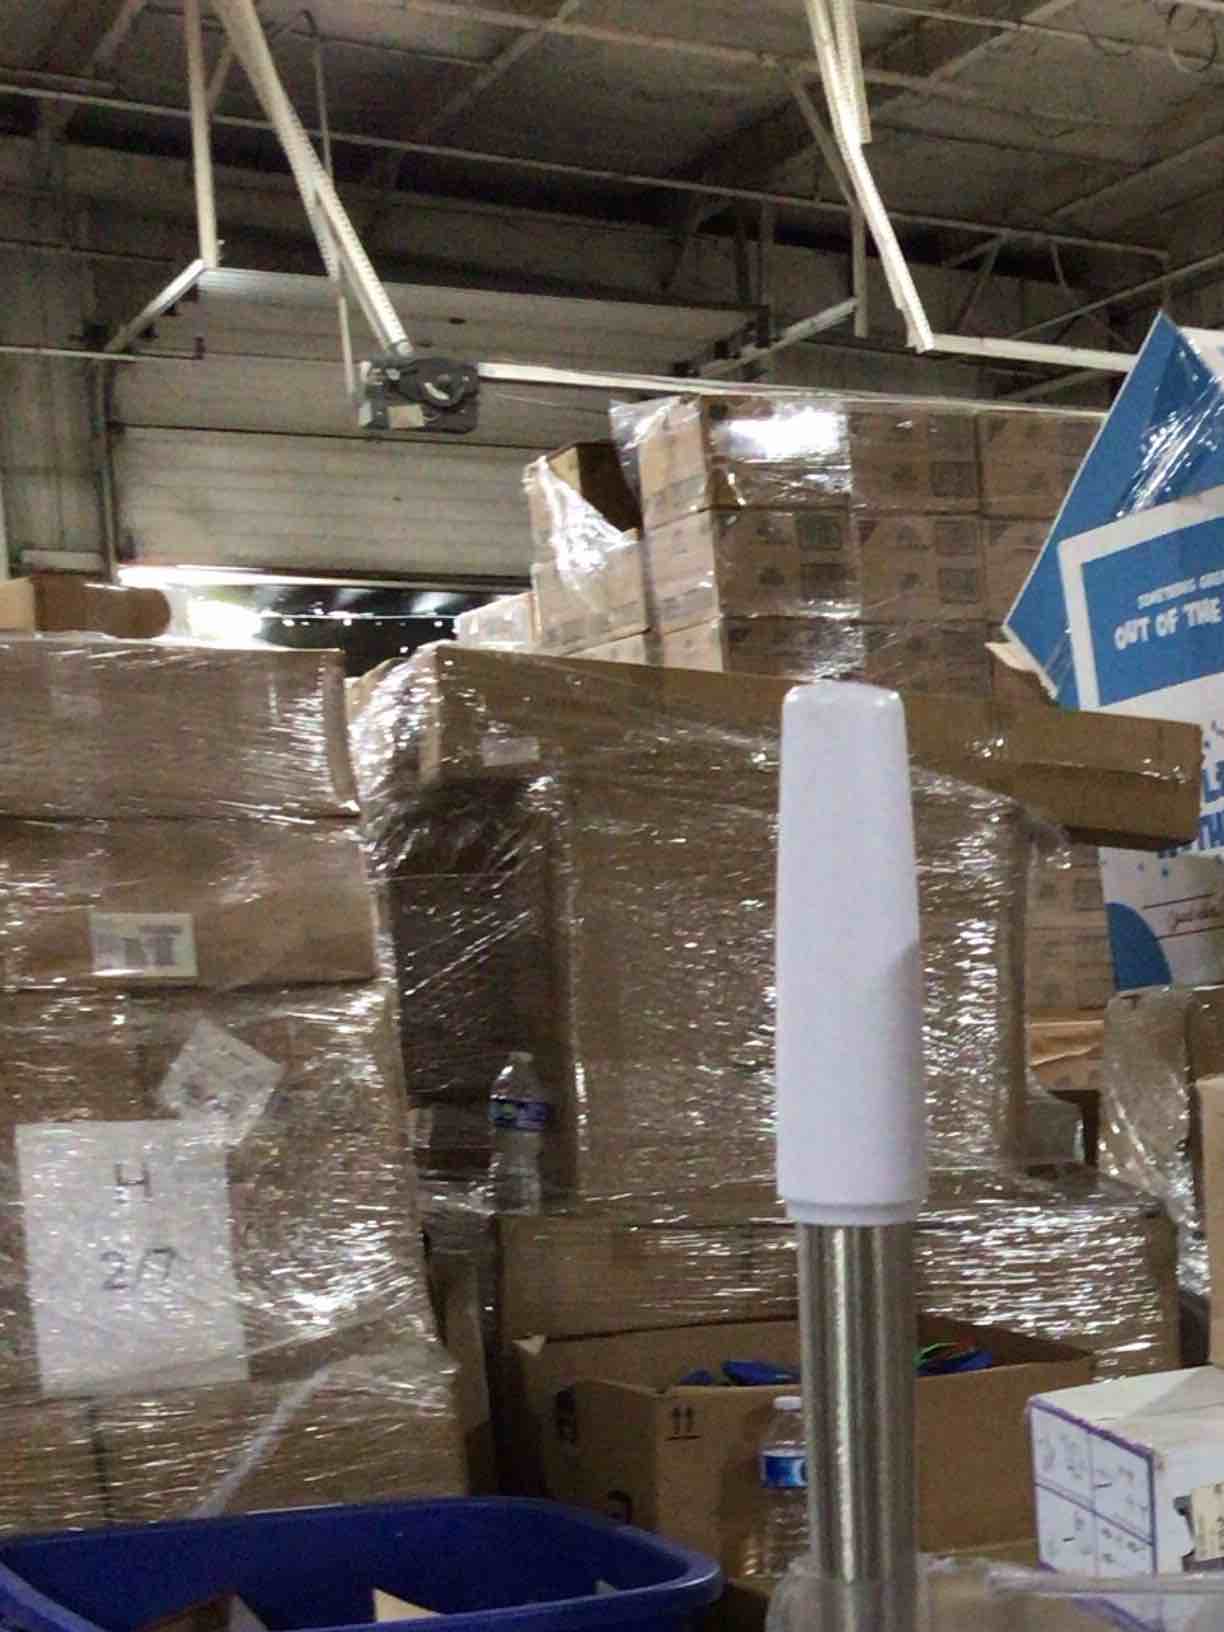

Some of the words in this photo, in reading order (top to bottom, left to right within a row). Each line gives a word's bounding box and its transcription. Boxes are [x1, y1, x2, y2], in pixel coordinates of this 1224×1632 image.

[1114, 615, 1150, 650] OUT
[1155, 606, 1179, 637] OF
[1182, 597, 1223, 627] THE
